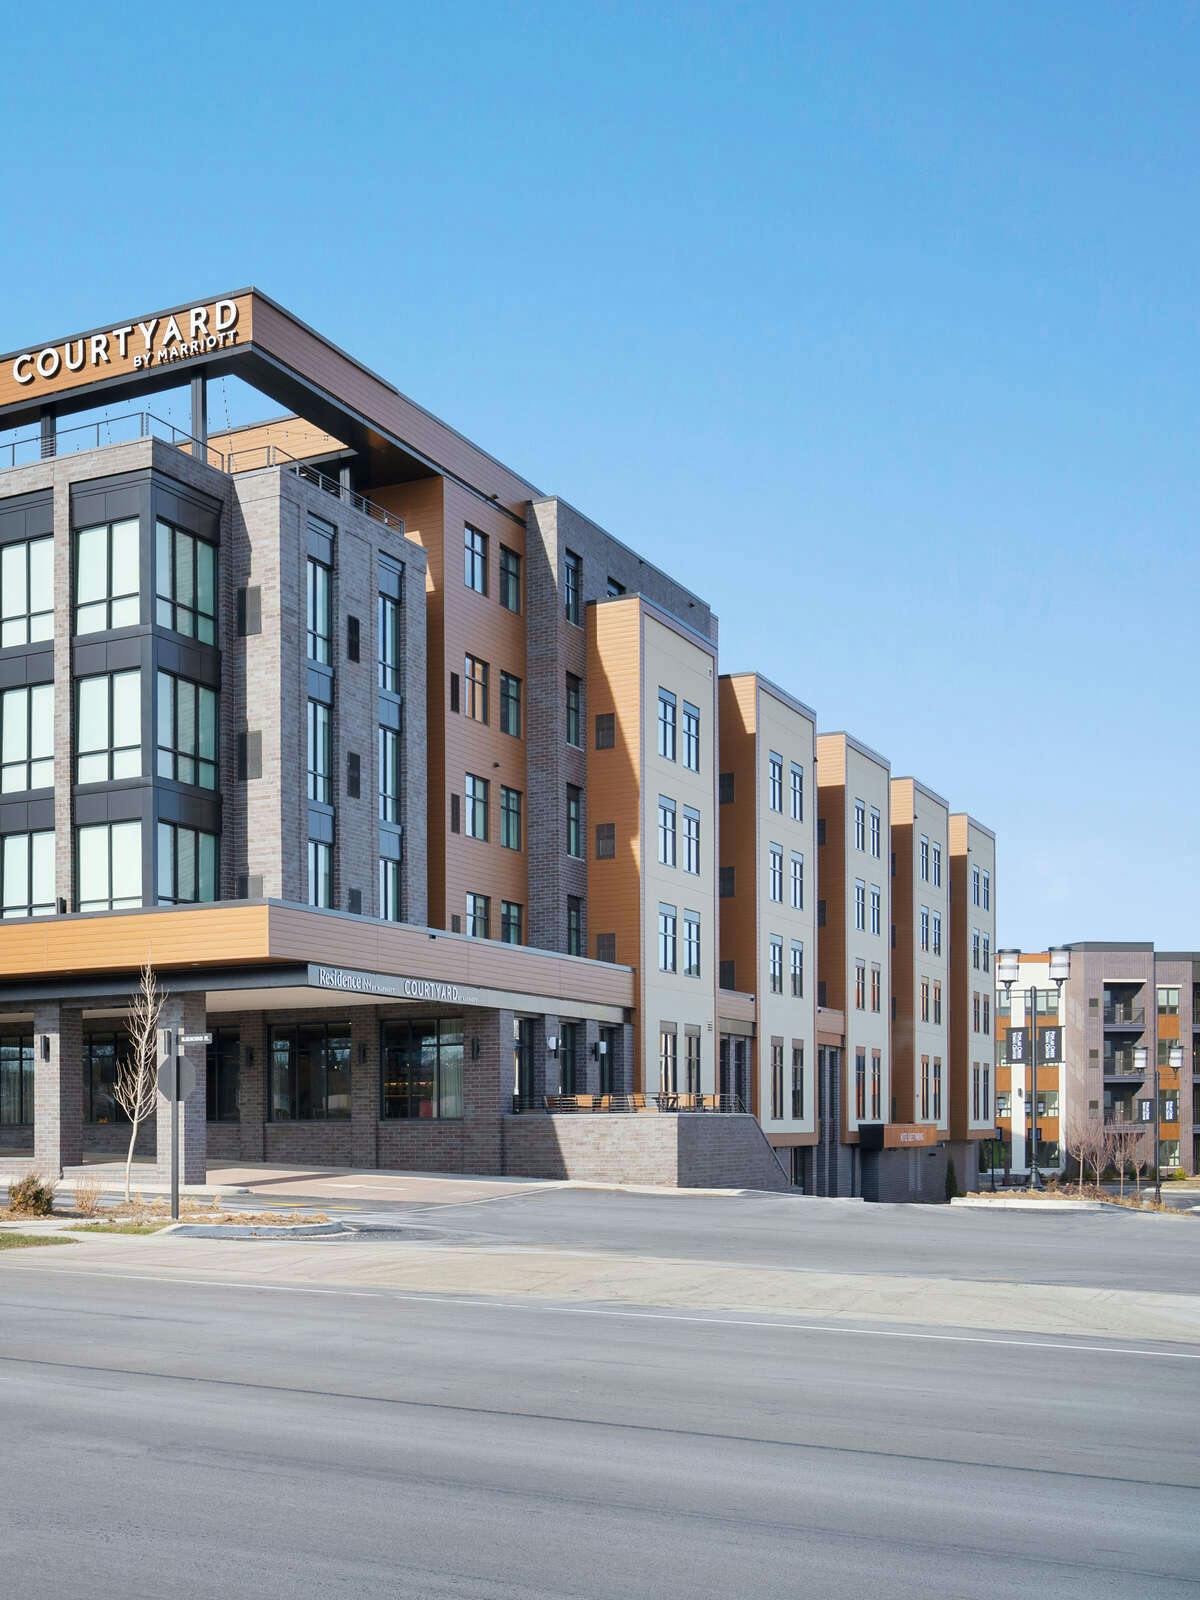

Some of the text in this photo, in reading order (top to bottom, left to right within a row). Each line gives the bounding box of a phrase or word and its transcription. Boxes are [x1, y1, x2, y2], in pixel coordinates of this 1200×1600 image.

[13, 300, 238, 384] COURTYARD
[133, 329, 238, 368] BY MARRIOTT
[319, 968, 362, 990] Residence
[404, 979, 458, 1001] COURTYARD
